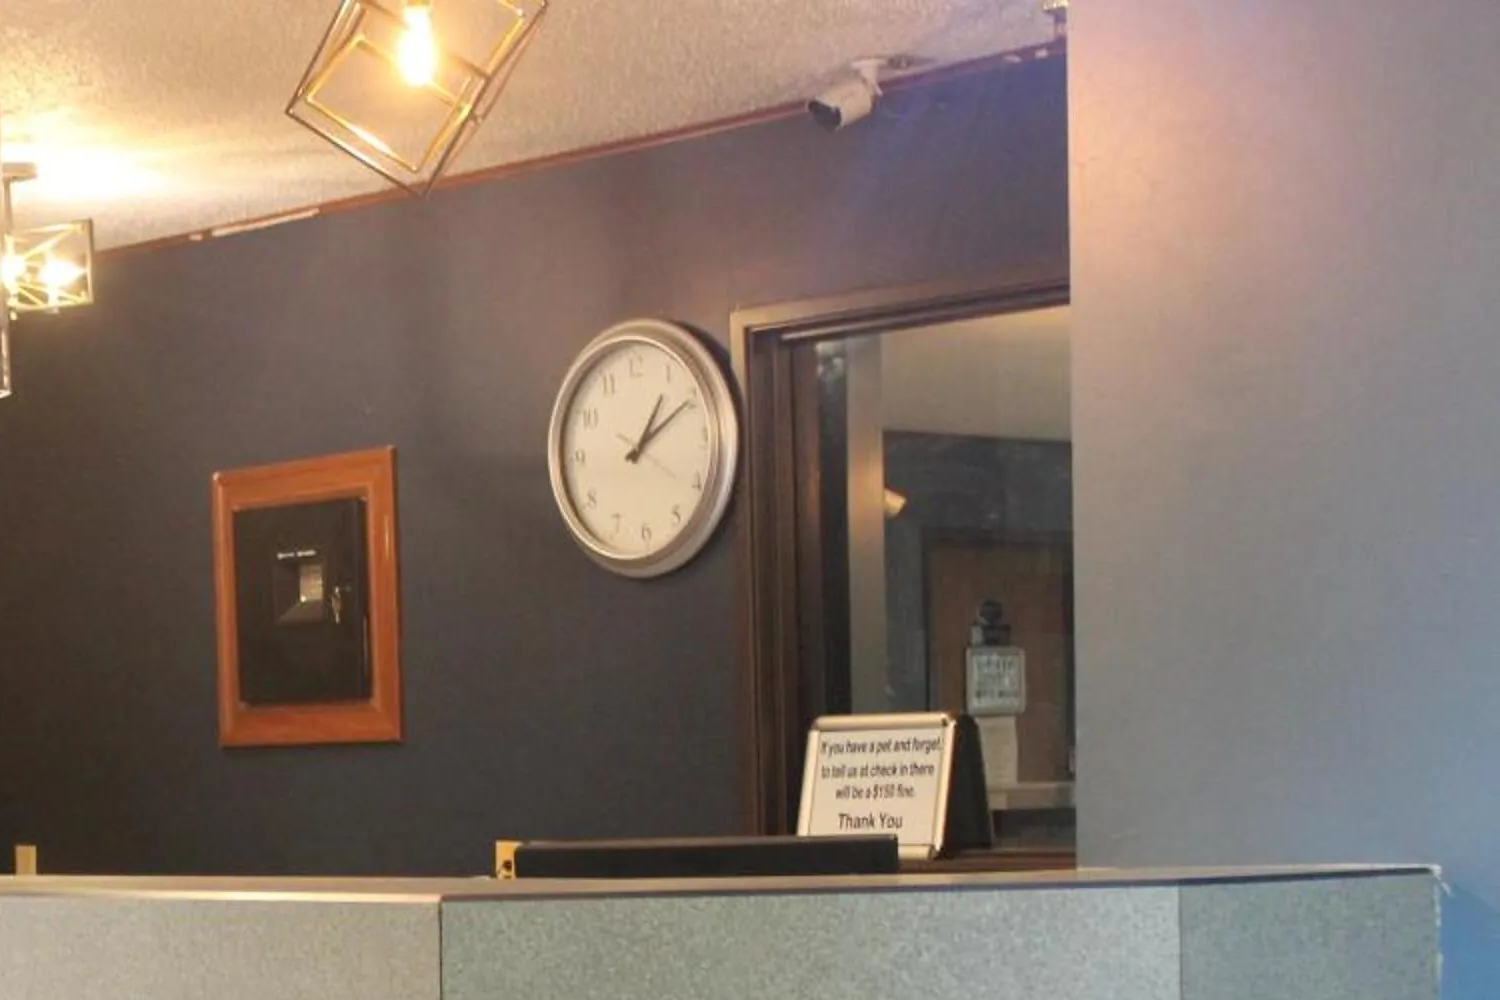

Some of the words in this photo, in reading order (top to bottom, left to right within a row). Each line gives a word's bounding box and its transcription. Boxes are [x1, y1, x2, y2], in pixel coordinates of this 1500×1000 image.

[629, 355, 644, 379] 12
[665, 363, 672, 385] 1
[602, 373, 616, 396] 11
[582, 407, 599, 430] 10
[575, 449, 586, 466] 9
[586, 488, 597, 509] 8
[610, 512, 622, 534] 7
[671, 504, 681, 526] 5
[641, 522, 652, 541] 6
[828, 743, 845, 758] you
[845, 740, 868, 753] have
[868, 742, 875, 753] a
[875, 738, 892, 757] pet
[893, 738, 911, 753] and
[912, 736, 941, 755] forget
[821, 764, 831, 779] to
[831, 764, 846, 779] tell
[847, 766, 858, 778] us
[859, 763, 869, 778] at
[869, 762, 898, 777] check
[899, 763, 909, 777] in
[909, 762, 935, 777] there
[835, 785, 851, 800] will
[851, 785, 864, 799] be
[864, 787, 871, 799] a
[872, 783, 895, 800] $150
[838, 811, 876, 830] Thank
[879, 811, 903, 830] You
